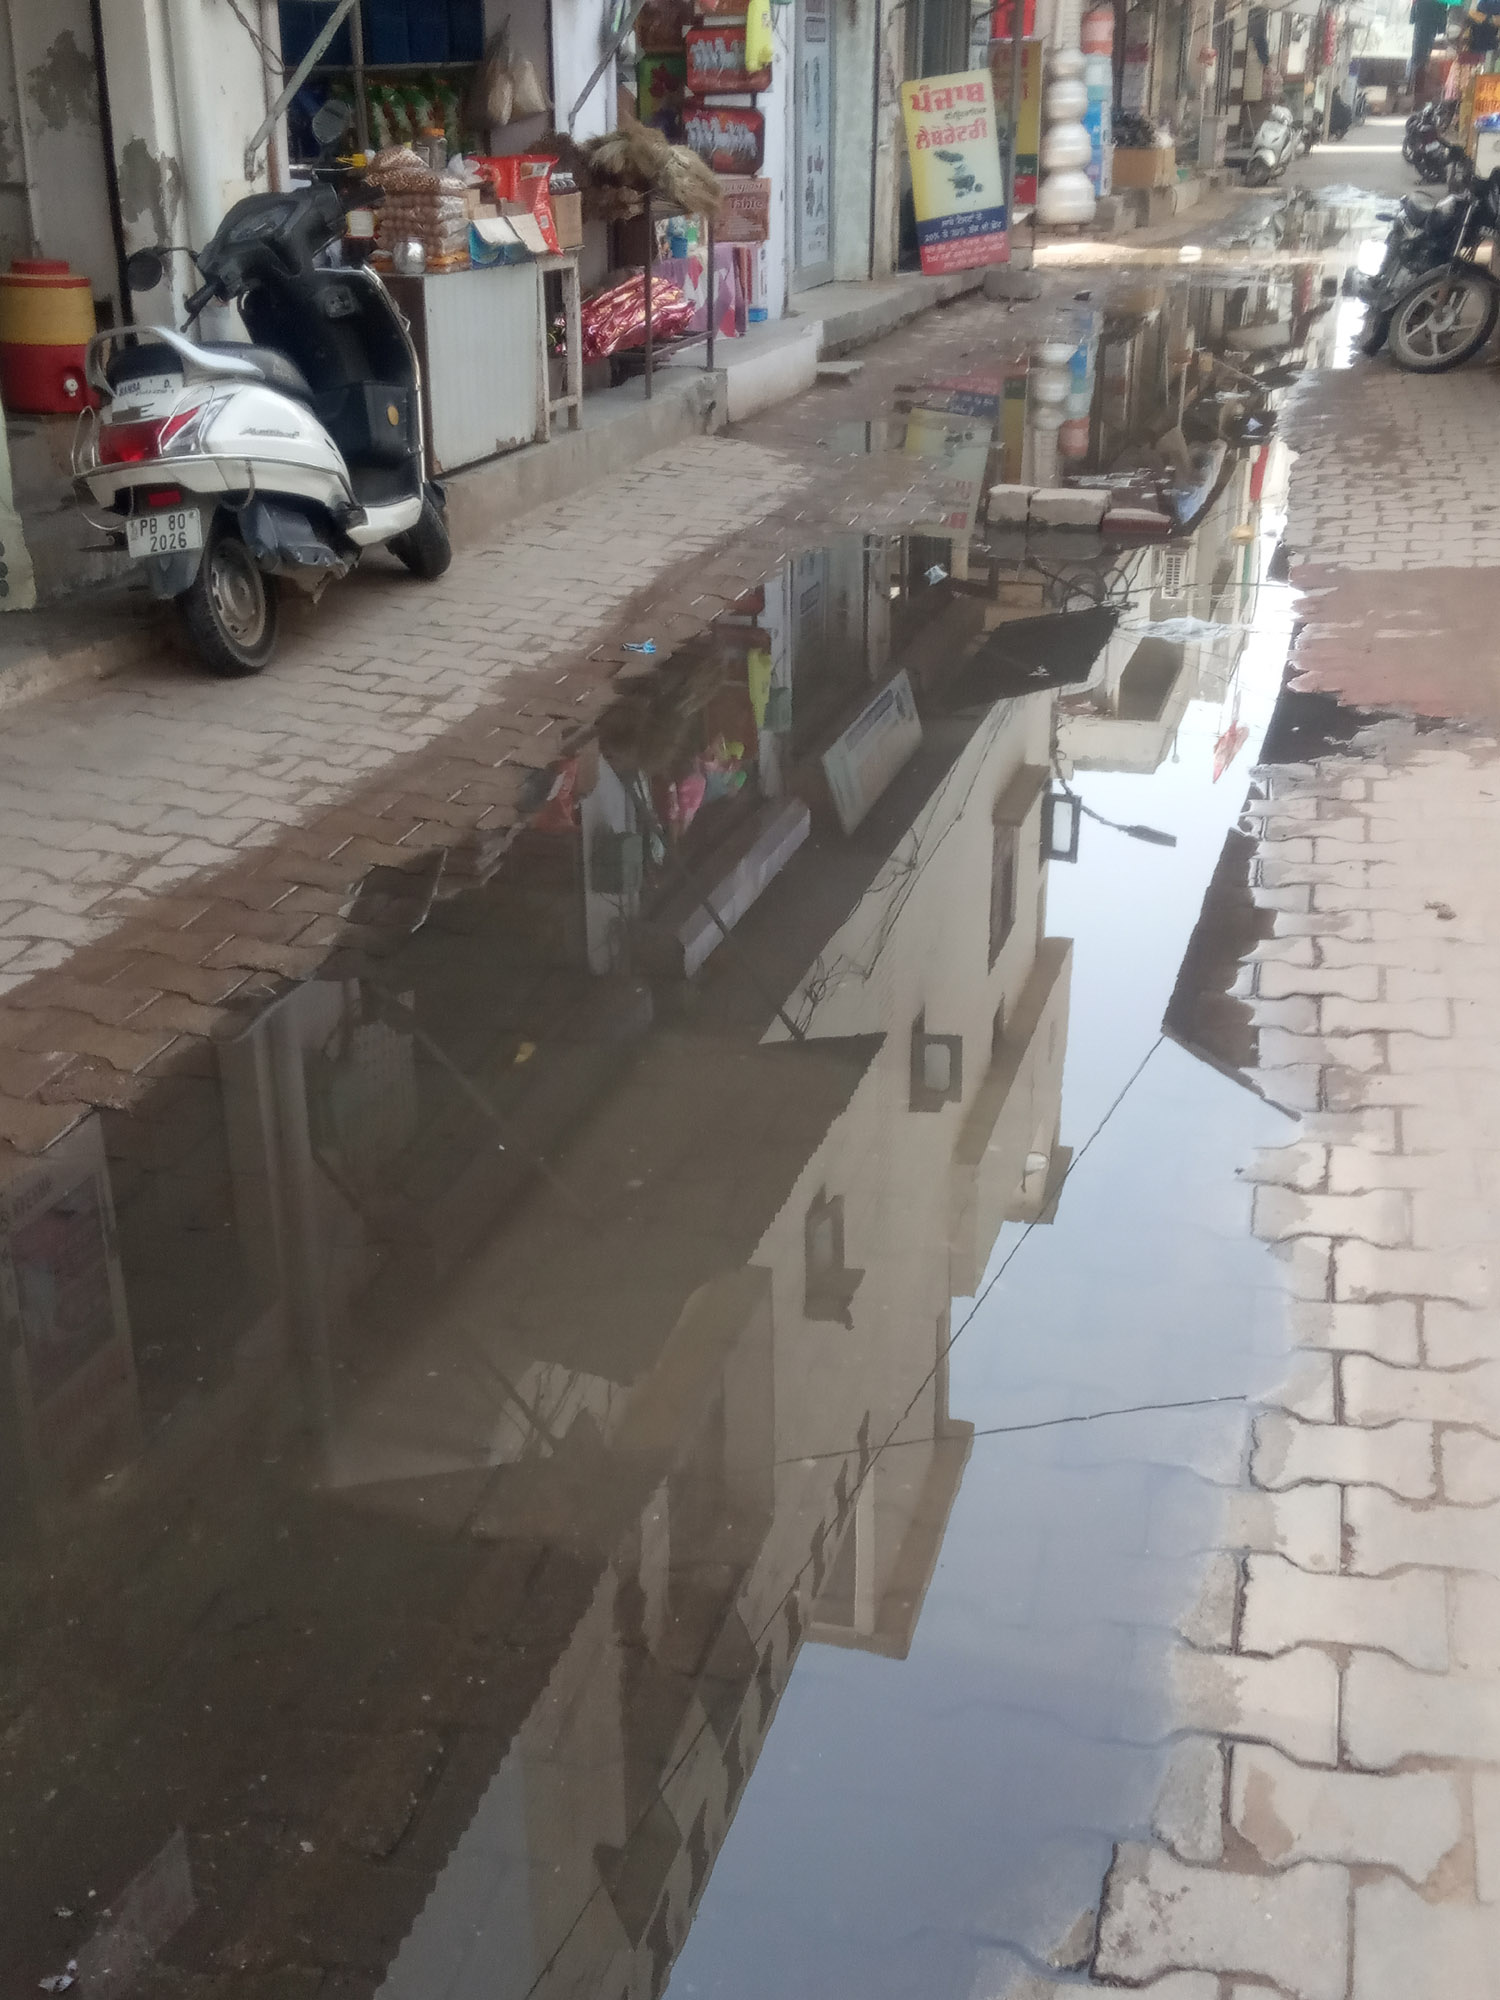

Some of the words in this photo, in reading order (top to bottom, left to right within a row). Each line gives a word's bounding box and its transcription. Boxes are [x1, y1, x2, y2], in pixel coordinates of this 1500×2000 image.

[910, 82, 985, 113] ਪੰਜਾਬ
[140, 518, 158, 537] PB
[168, 513, 186, 531] 80
[150, 531, 187, 553] 2026
